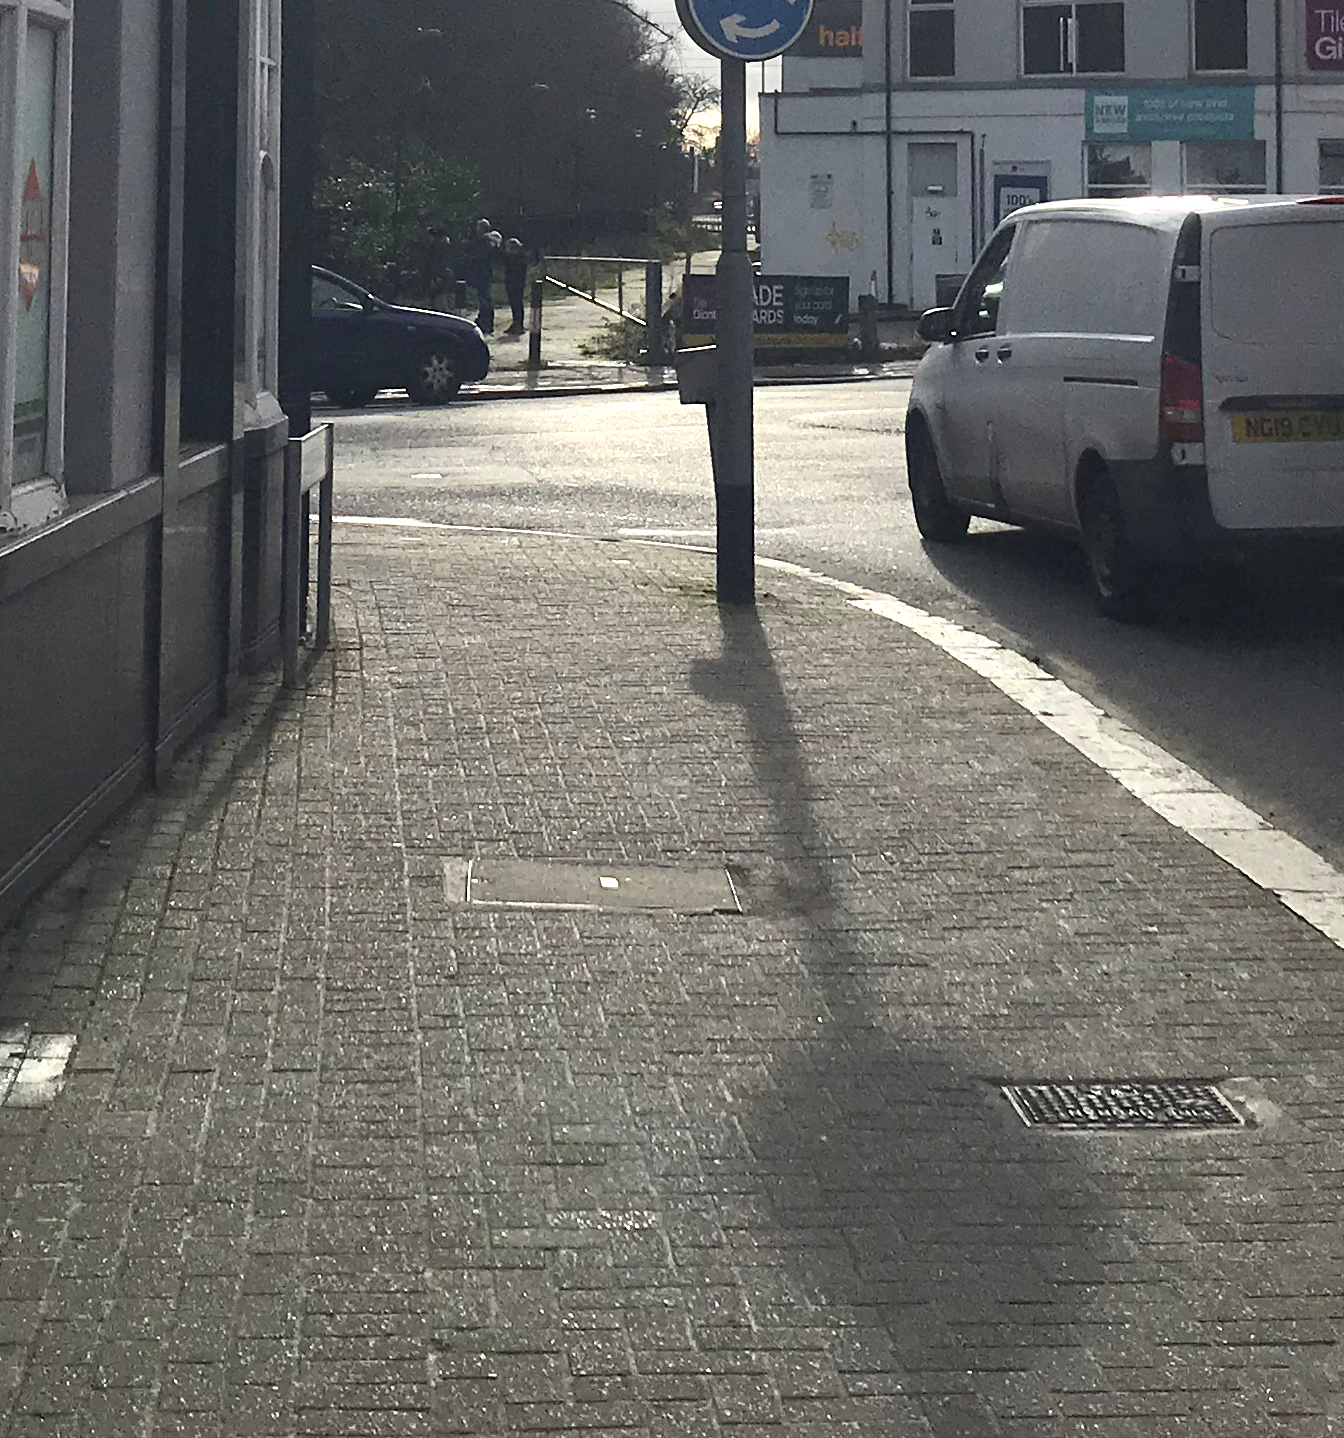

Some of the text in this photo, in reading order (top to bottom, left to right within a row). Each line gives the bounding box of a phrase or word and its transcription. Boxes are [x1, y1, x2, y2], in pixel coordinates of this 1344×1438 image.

[1095, 104, 1126, 116] NEW
[753, 309, 784, 324] ARDS
[793, 313, 819, 325] today
